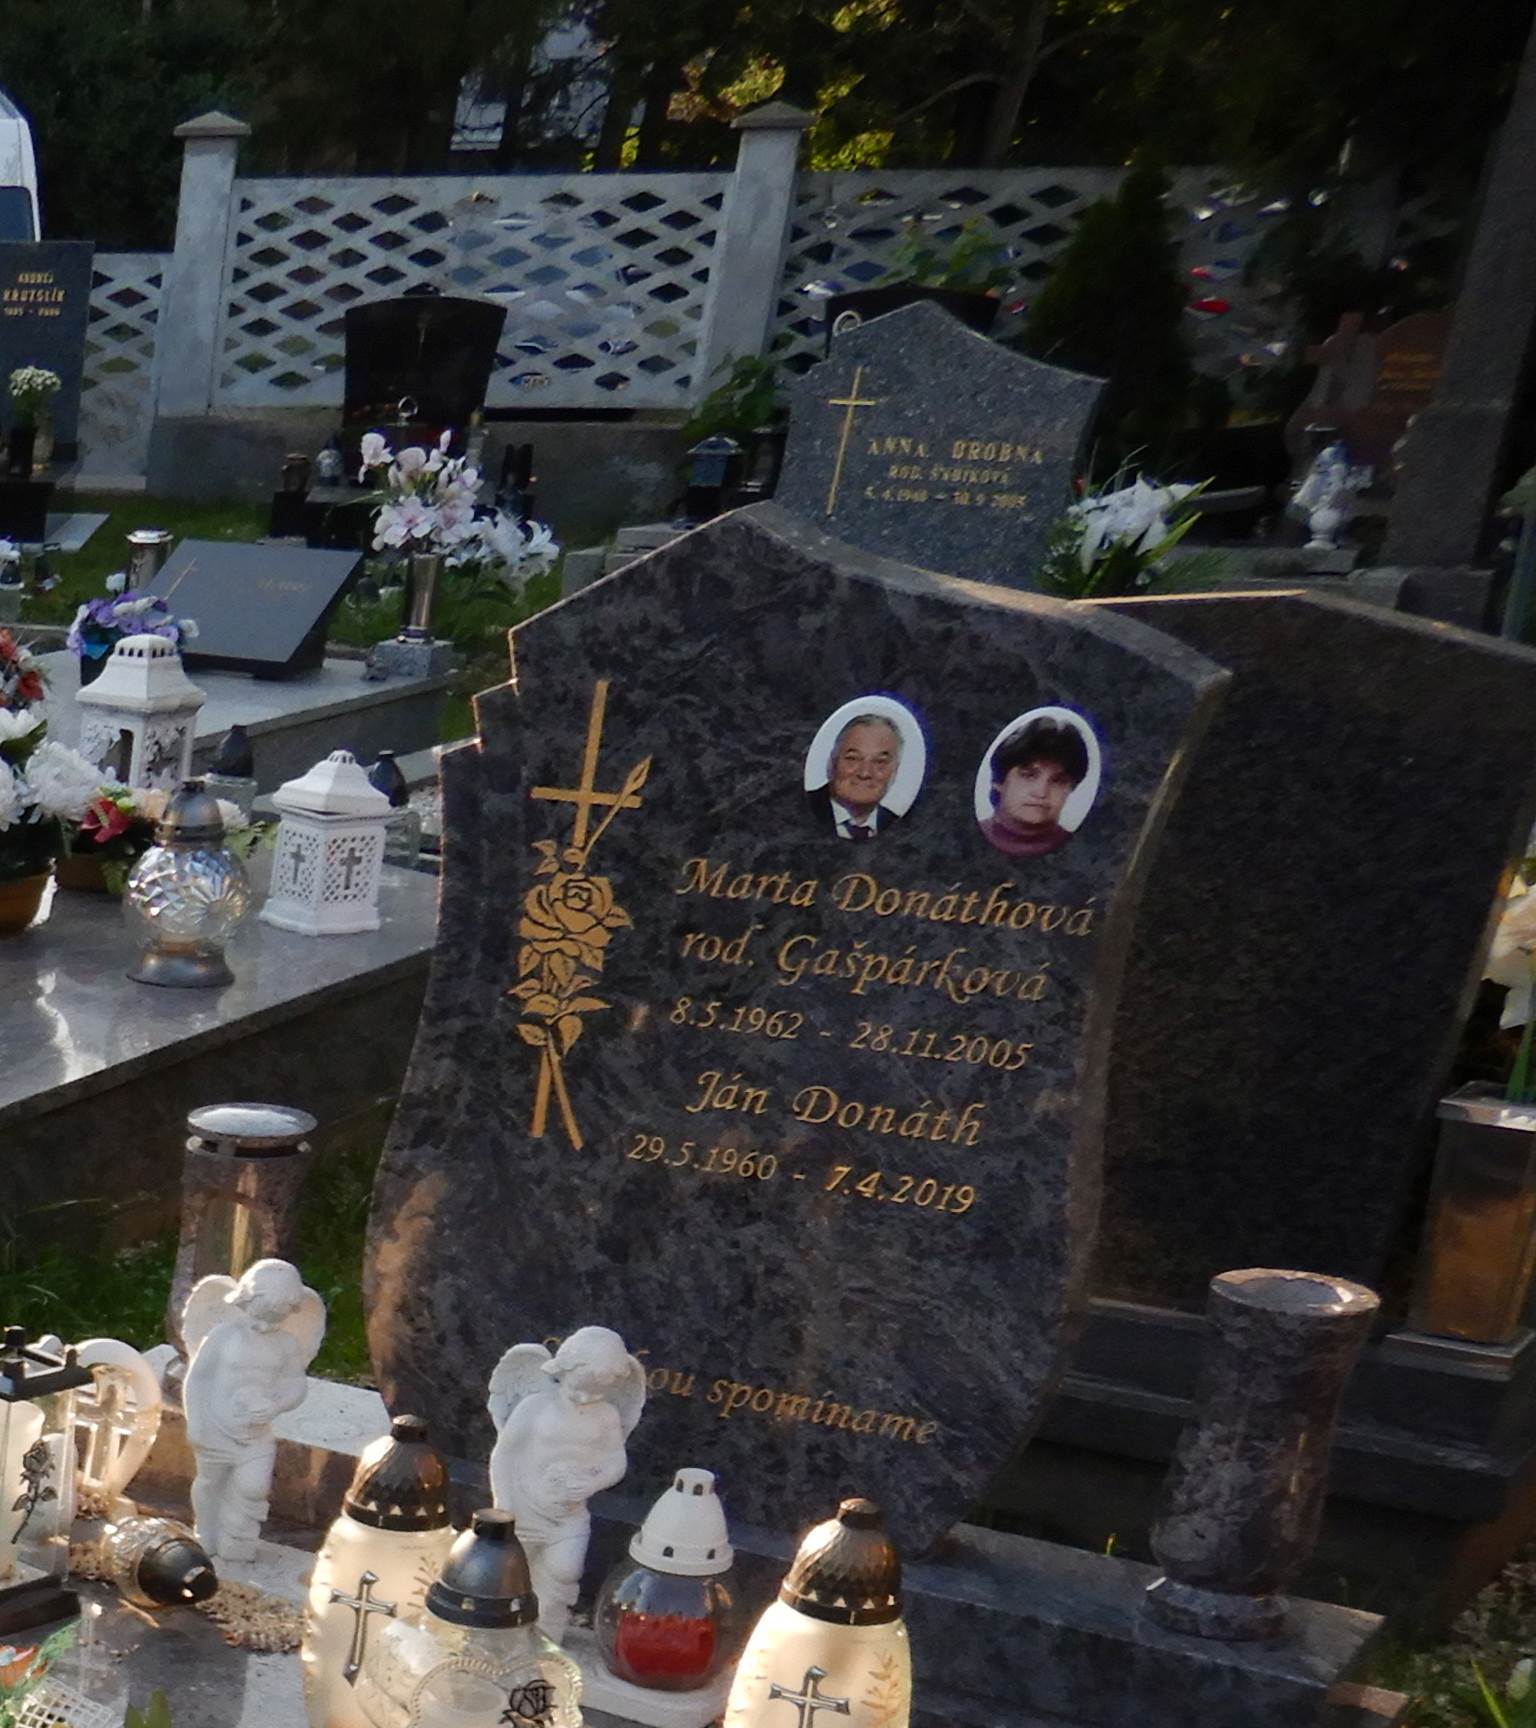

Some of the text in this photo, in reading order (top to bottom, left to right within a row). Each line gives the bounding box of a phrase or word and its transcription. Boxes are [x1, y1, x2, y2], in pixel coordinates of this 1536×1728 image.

[675, 857, 1098, 938] Marta Donáthová
[678, 923, 1052, 1005] rod. Gašpárková
[669, 996, 805, 1040] 8.5.1962
[849, 1021, 1034, 1072] 28.11.2005
[685, 1070, 986, 1147] Ján Donáth
[627, 1134, 780, 1181] 29.5.1960
[825, 1164, 977, 1215] 7.4.2019
[705, 1377, 939, 1446] spomíname
